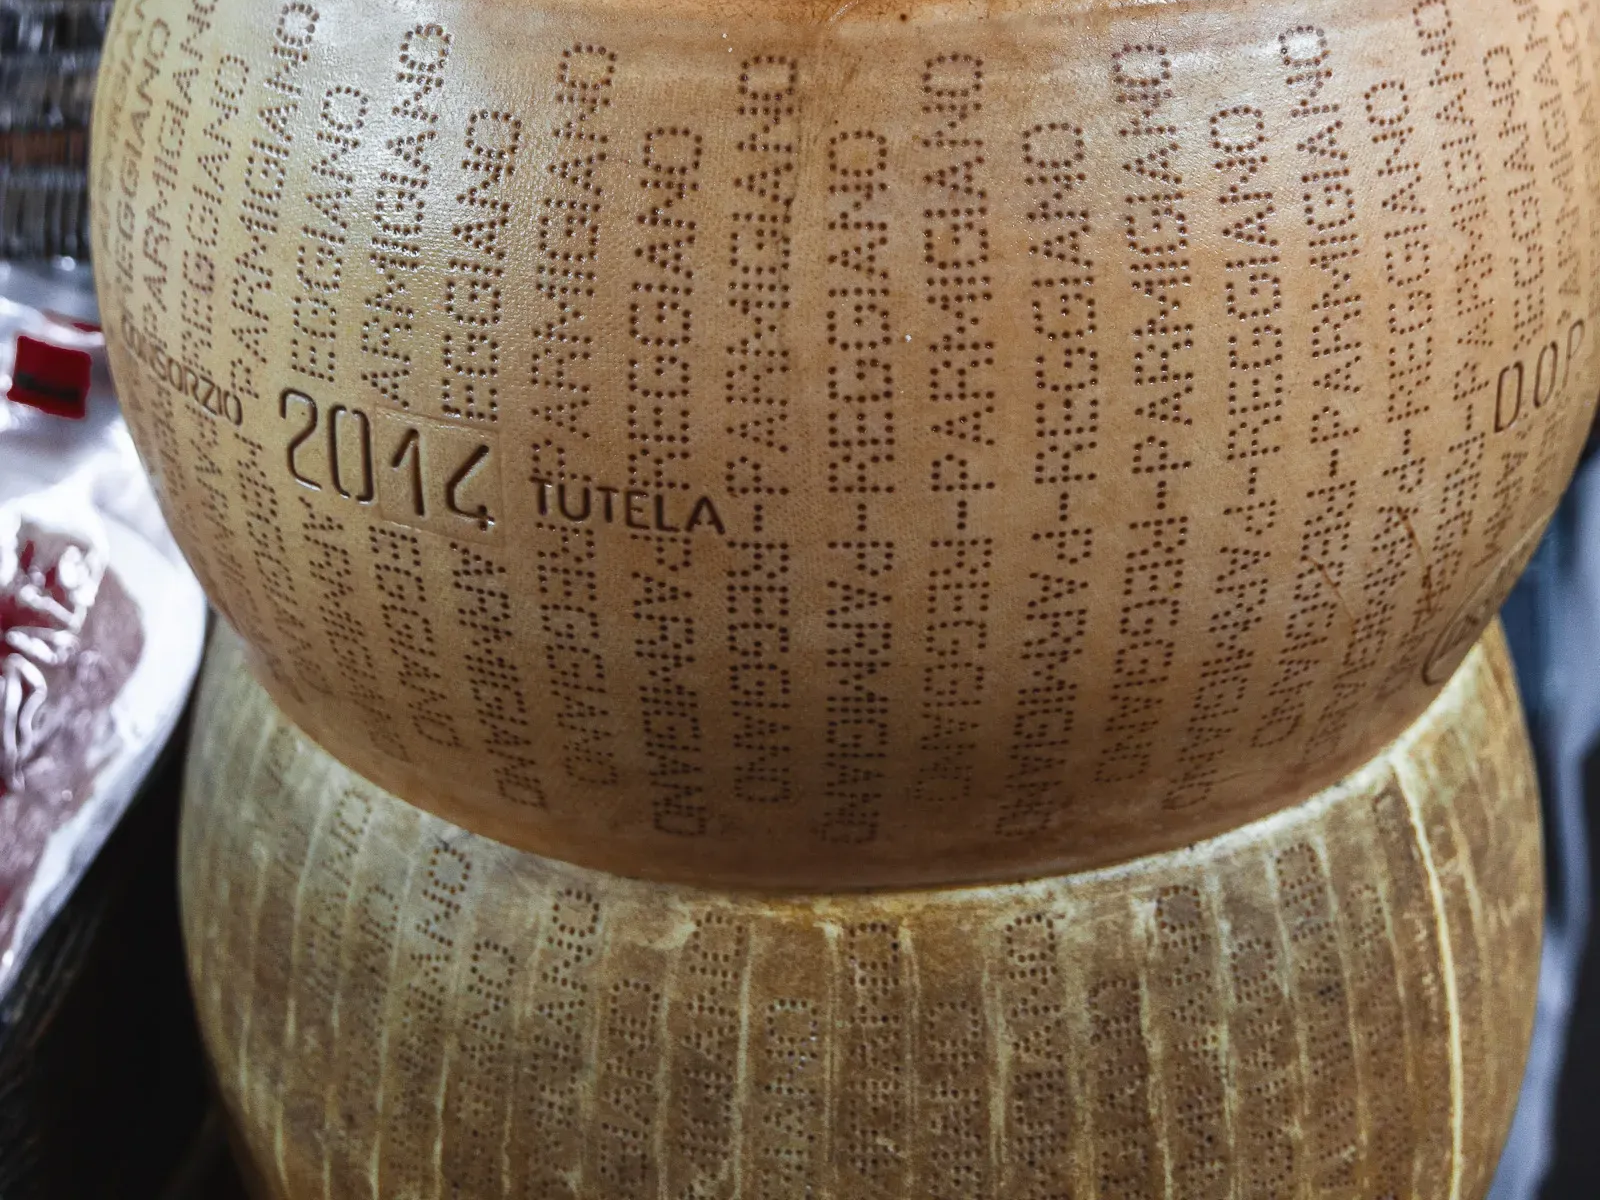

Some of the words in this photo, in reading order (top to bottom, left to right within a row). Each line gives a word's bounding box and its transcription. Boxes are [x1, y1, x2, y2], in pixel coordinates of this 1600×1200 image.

[230, 0, 319, 400] PARMIGIANO
[530, 41, 618, 483] PARMIGIANO
[629, 125, 703, 491] REGGIANO
[727, 54, 798, 496] PARMIGIANO
[826, 129, 894, 494] REGGIANO
[922, 52, 995, 491] PARMIGIANO
[1022, 121, 1099, 485] REGGIANO
[1111, 44, 1195, 473] PARMIGIANO
[1209, 106, 1283, 460] REGGIANO
[1280, 24, 1361, 444] PARMIGIANO
[1364, 80, 1434, 425] REGGIANO
[279, 387, 497, 529] 2014
[531, 476, 726, 536] TUTELA
[536, 522, 618, 787] REGGIANO
[630, 531, 707, 838] PARMIGIANO
[727, 542, 790, 804] REGGIANO
[821, 541, 895, 845] PARMIGIANO
[915, 539, 992, 800] REGGIANO
[1097, 516, 1189, 787] REGGIANO
